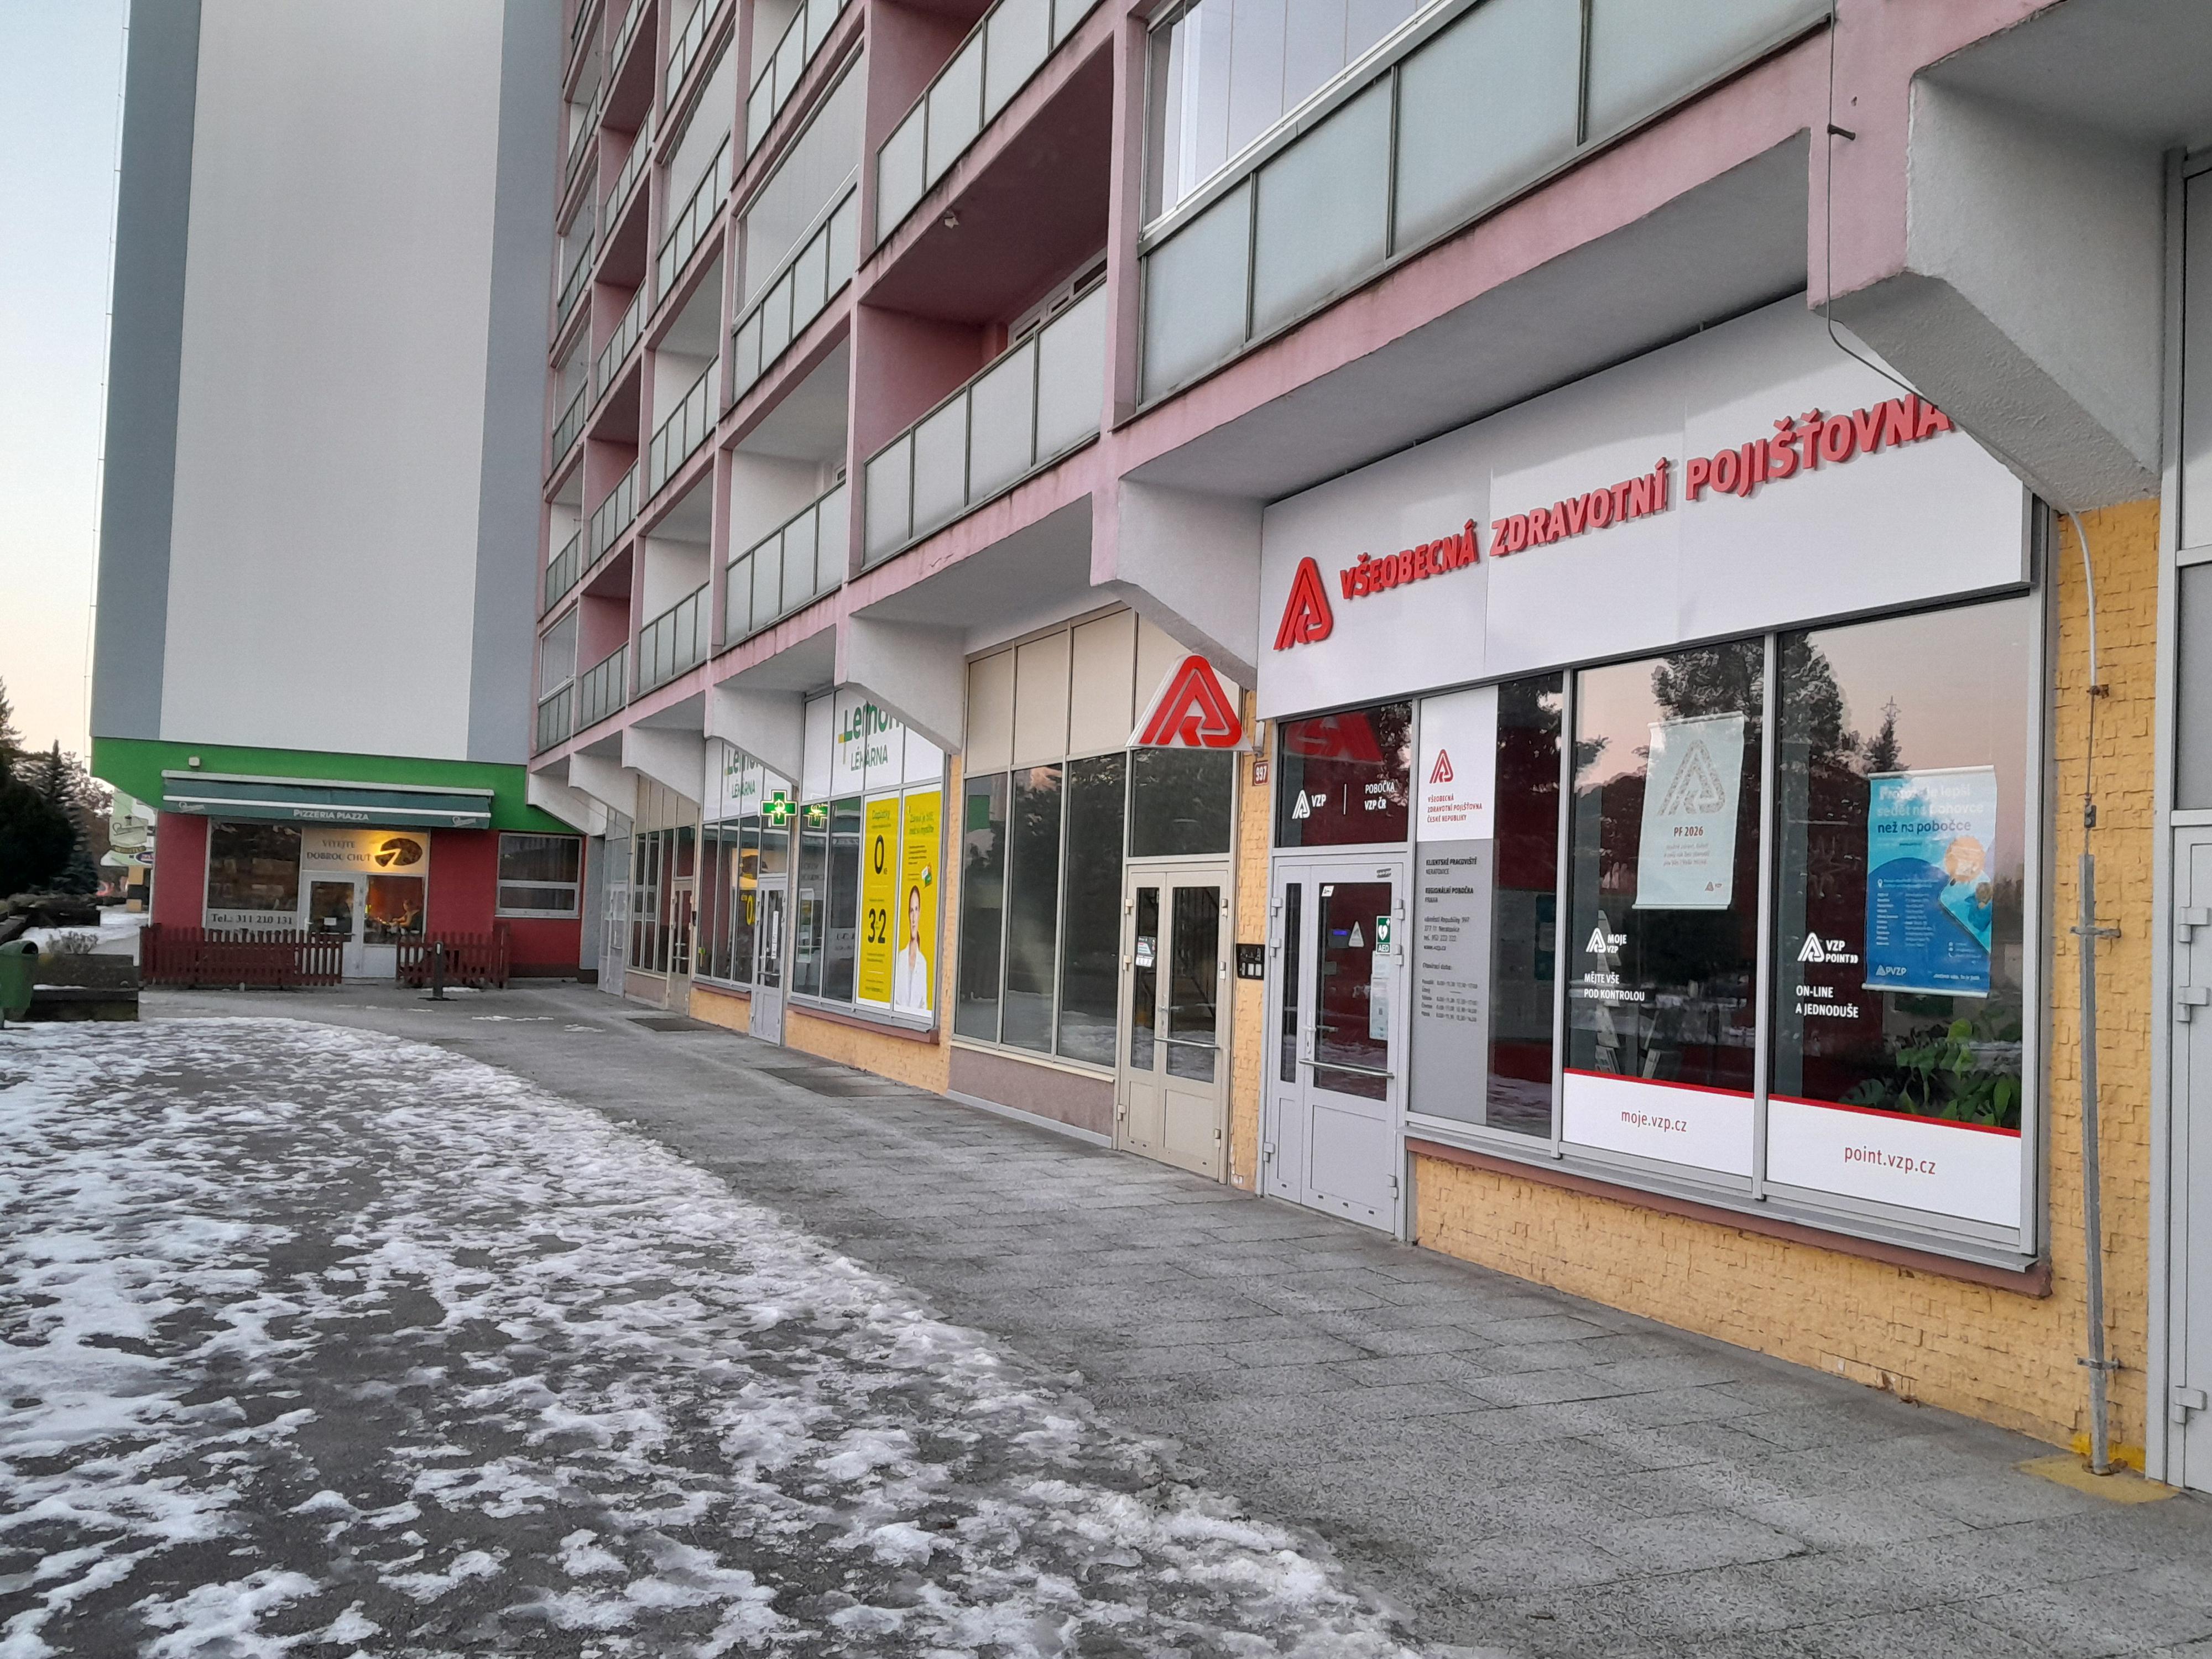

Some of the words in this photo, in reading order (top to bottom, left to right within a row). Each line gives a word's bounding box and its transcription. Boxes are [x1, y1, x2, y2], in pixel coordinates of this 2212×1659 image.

[1340, 518, 1479, 599] VŠEOBECNÁ
[1489, 457, 1670, 557] ZDRAVOTNÍ
[1256, 765, 1267, 781] 997
[1365, 780, 1395, 794] POBOČKA
[1311, 794, 1327, 807] VZP
[1364, 800, 1376, 811] VZP
[1378, 797, 1386, 810] ČR
[1428, 793, 1454, 802] VŠEOBECNÁ
[1427, 804, 1453, 813] ZDRAVOTNÍ
[1453, 802, 1483, 812] POJIŠŤOVNA
[293, 809, 335, 819] PIZZERIA
[337, 812, 369, 821] PIAZZA
[1442, 814, 1467, 822] REPUBLIKY
[1674, 827, 1683, 837] PF
[1684, 826, 1703, 836] 2026
[1877, 821, 1898, 833] než
[1901, 822, 1914, 833] na
[1917, 819, 1971, 834] pobočce
[237, 915, 252, 923] 311
[257, 915, 273, 924] 210
[278, 916, 292, 925] 131
[1608, 933, 1627, 946] MOJE
[1826, 940, 1845, 952] VZP
[1607, 945, 1619, 953] VZP
[1825, 953, 1850, 963] POINT
[1584, 971, 1605, 984] MĚJTE
[1606, 972, 1620, 984] VŠE
[1584, 988, 1599, 999] POD
[1600, 989, 1645, 1001] KONTROLOU
[1796, 985, 1834, 998] ON-LINE
[1795, 1003, 1802, 1014] A
[1804, 1003, 1859, 1019] JEDNODUŠE
[1621, 1110, 1687, 1133] moje.vzp.cz
[1845, 1145, 1936, 1174] point.vzp.cz
